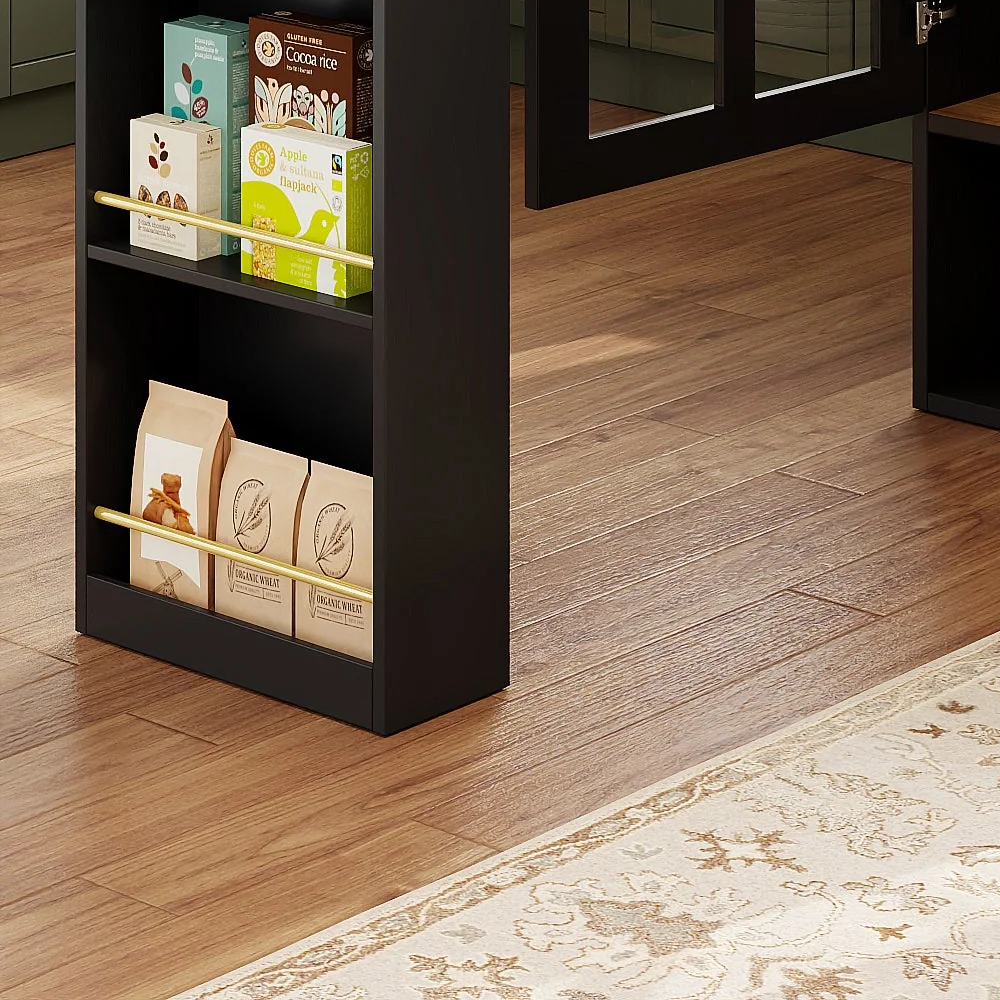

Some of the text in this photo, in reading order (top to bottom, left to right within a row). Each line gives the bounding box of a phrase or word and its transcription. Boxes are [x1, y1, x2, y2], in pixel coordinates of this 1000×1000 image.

[286, 32, 323, 46] GLUTEN FREE
[286, 46, 318, 67] Cocoa
[319, 52, 338, 71] rice
[280, 146, 308, 162] Apple
[280, 161, 325, 181] & sultana
[280, 175, 317, 194] flapjack
[235, 568, 280, 589] ORGANIC WHEAT
[316, 594, 363, 615] ORGANIC WHEAT
